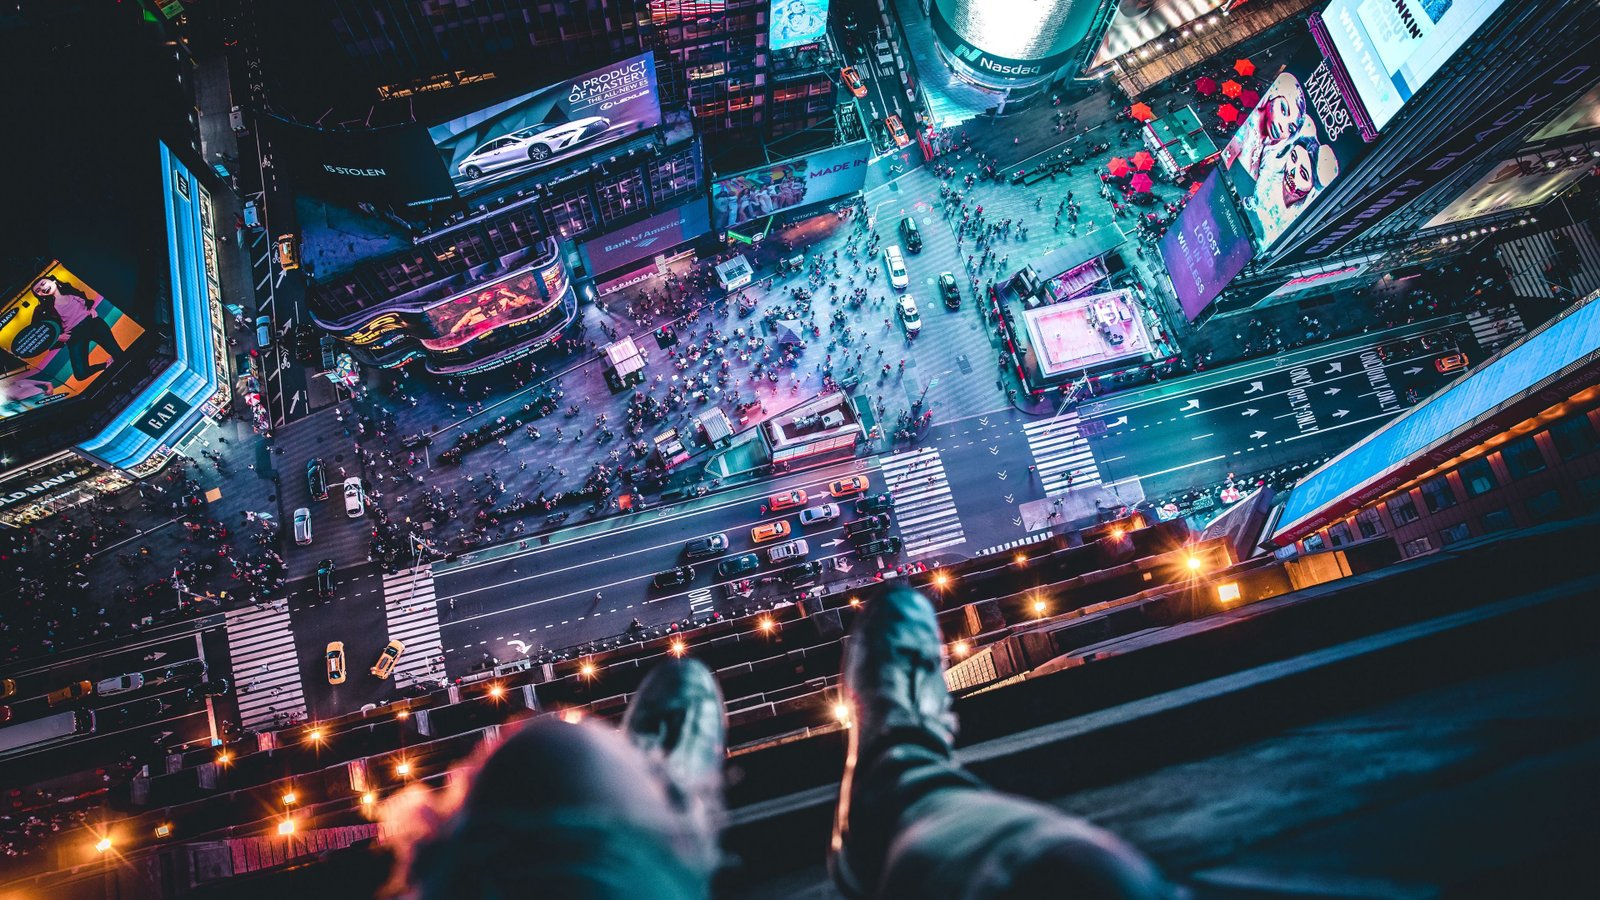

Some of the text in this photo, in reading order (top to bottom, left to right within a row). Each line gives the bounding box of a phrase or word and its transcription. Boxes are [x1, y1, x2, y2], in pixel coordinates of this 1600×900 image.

[1340, 6, 1364, 52] WITH
[1380, 0, 1409, 42] ONUT
[1391, 0, 1423, 39] NKIN'
[572, 60, 647, 93] A PRODUCT
[980, 57, 1042, 75] Nasdaq
[568, 69, 647, 103] OF MASTERY
[587, 96, 602, 105] THE
[604, 83, 638, 99] ALL-NEW
[613, 90, 649, 105] LEXUS
[1314, 61, 1353, 133] FANTASY
[1304, 73, 1341, 141] MAKERS
[323, 164, 386, 177] IS STOLEN
[809, 157, 868, 179] MADE IN
[604, 239, 631, 252] Bank
[643, 218, 686, 237] America
[1194, 225, 1214, 268] LOVED
[1202, 219, 1220, 256] MOST
[605, 272, 655, 294] SEPHORA
[148, 403, 178, 430] GAP
[25, 470, 78, 494] NAVY
[688, 589, 714, 614] ONLY
